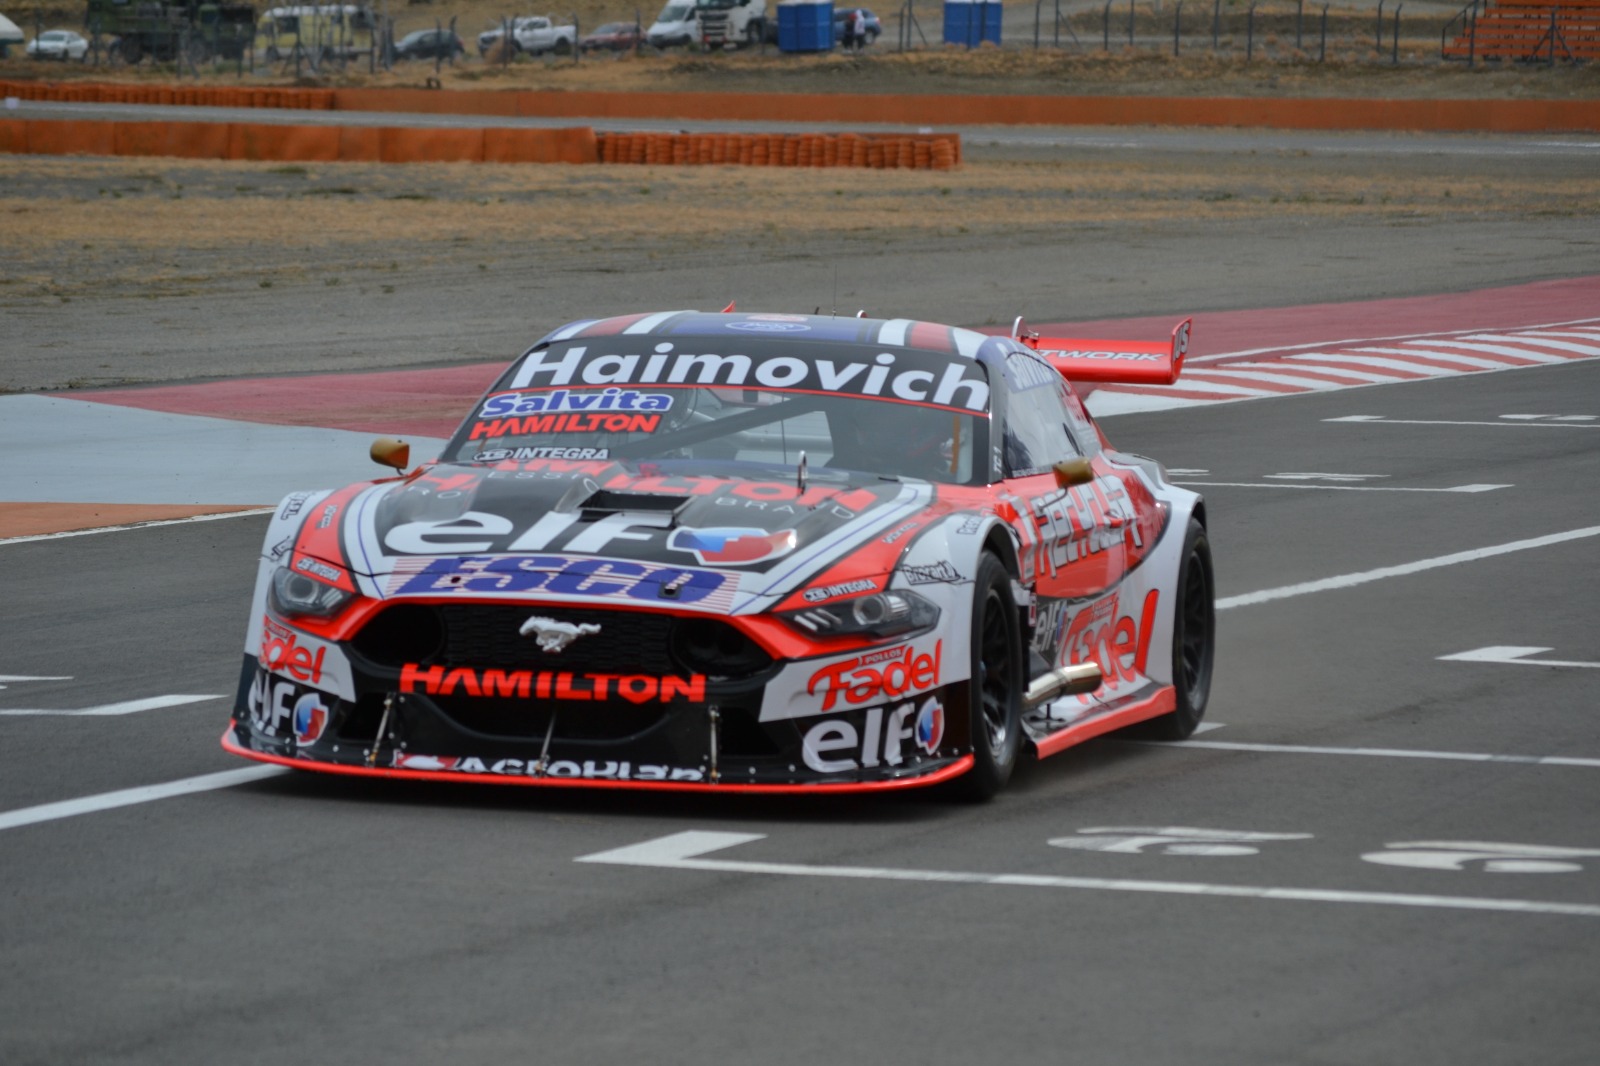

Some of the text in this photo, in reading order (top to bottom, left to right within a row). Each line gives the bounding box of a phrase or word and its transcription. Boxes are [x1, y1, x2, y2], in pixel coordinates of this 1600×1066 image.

[510, 343, 990, 412] Haimovich
[480, 388, 673, 418] Salvita
[469, 414, 661, 440] HAMILTON
[513, 447, 608, 459] INTEGRA
[400, 663, 706, 703] HAMILTON
[807, 639, 942, 712] Fadel
